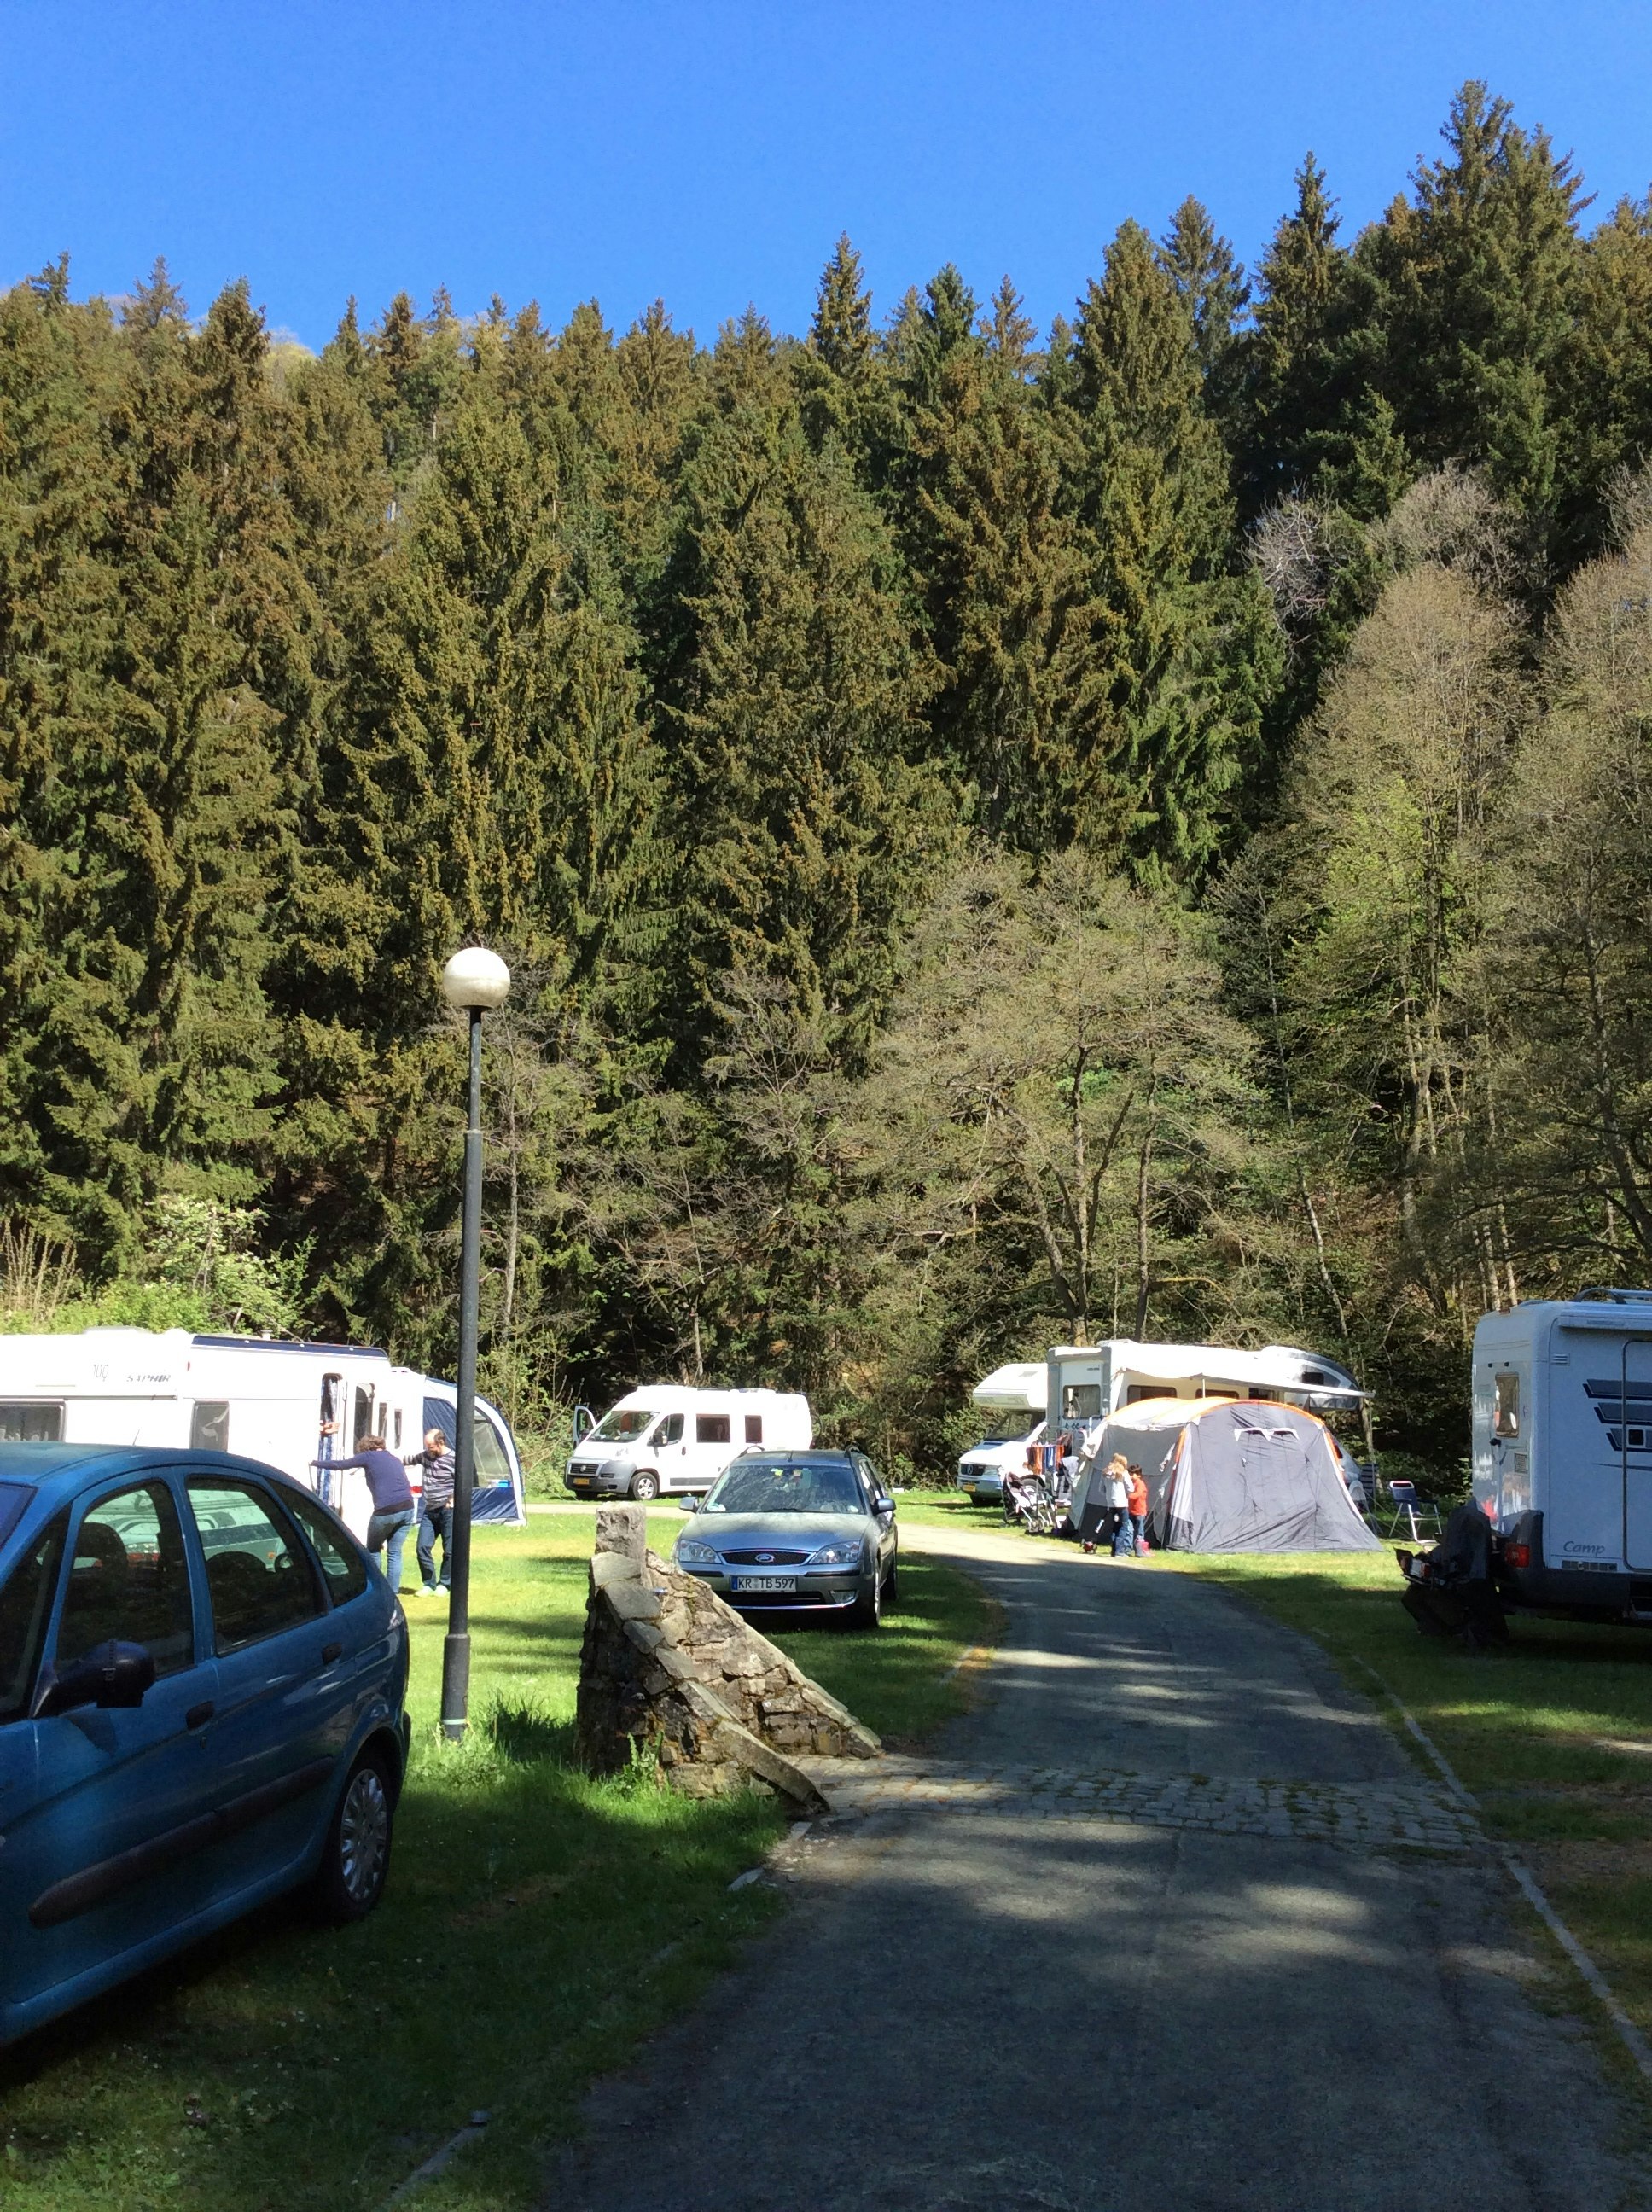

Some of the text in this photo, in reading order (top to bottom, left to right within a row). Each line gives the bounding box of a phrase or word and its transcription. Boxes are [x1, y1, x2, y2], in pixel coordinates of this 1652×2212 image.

[1562, 1540, 1606, 1557] Camp
[738, 1578, 795, 1589] KR TB 597
